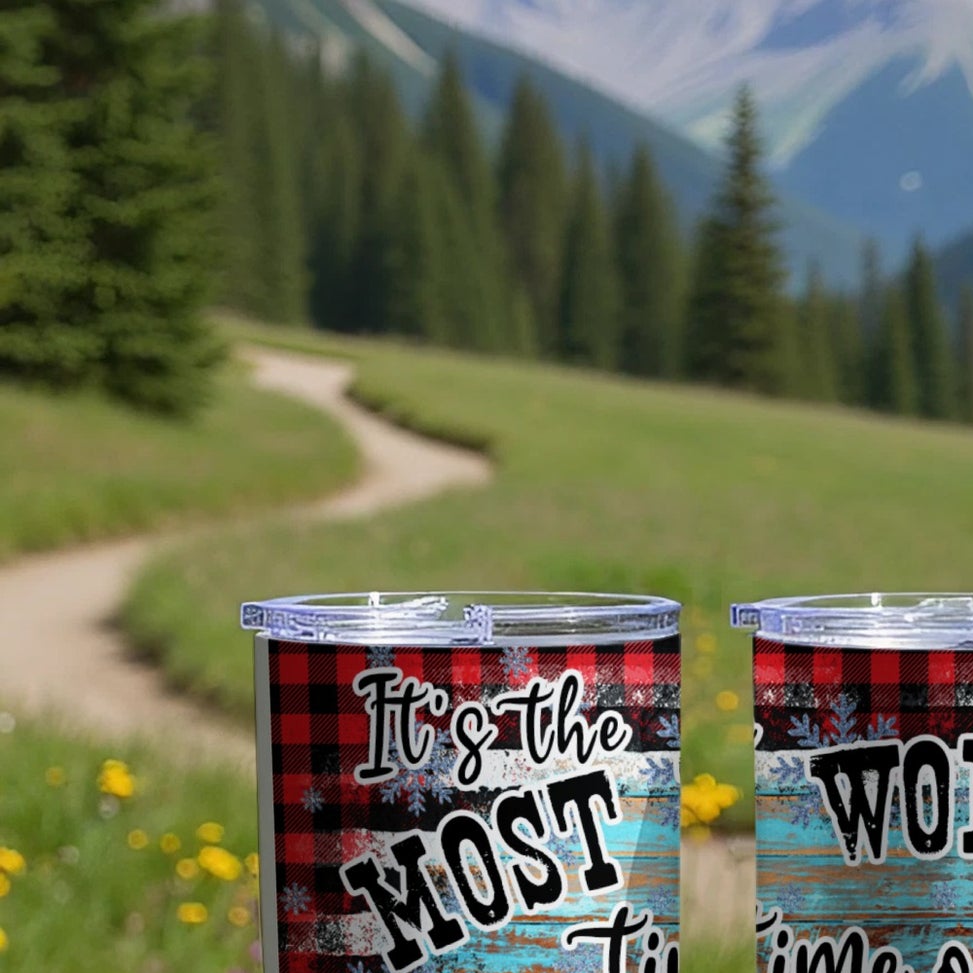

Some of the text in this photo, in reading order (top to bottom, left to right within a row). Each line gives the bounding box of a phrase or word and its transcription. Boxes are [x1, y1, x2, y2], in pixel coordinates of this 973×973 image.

[358, 672, 628, 785] It's the
[345, 770, 620, 972] MOST
